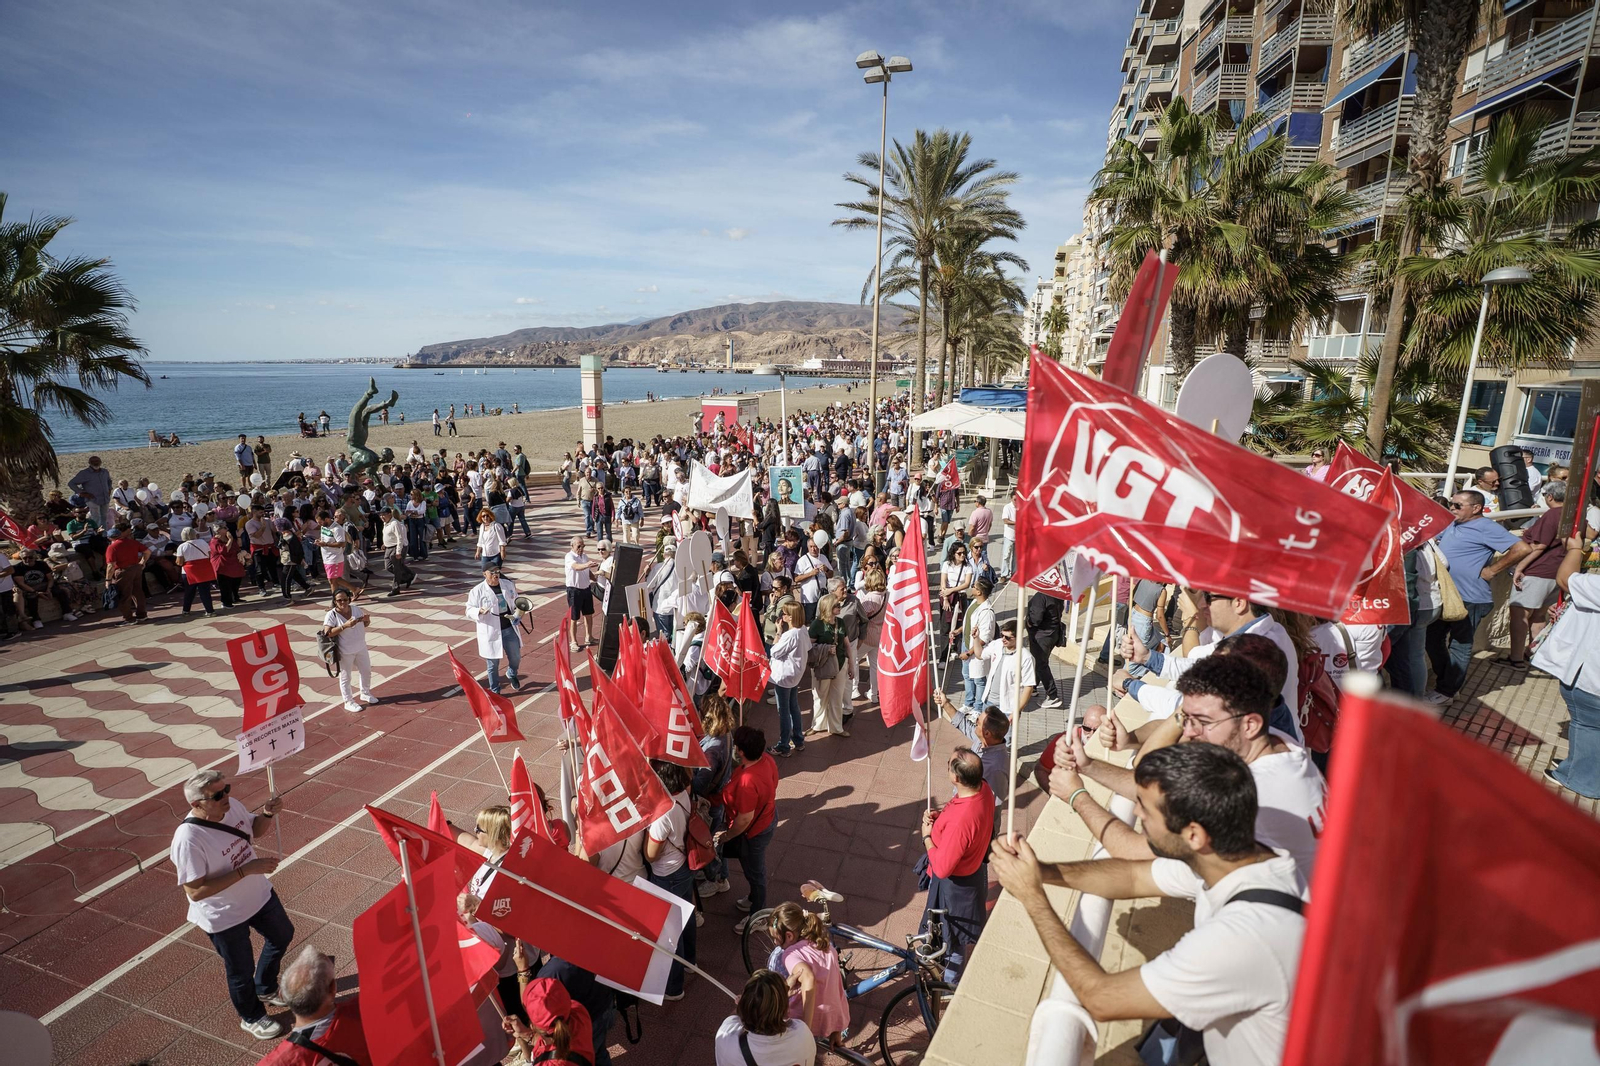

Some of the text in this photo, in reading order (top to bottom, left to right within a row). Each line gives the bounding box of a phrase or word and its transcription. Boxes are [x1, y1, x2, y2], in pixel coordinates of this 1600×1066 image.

[1068, 418, 1214, 529] UGT
[241, 633, 290, 719] UGT
[242, 717, 300, 750] LOS RECORTES MATAN
[587, 726, 642, 834] COO
[494, 897, 511, 910] UGT
